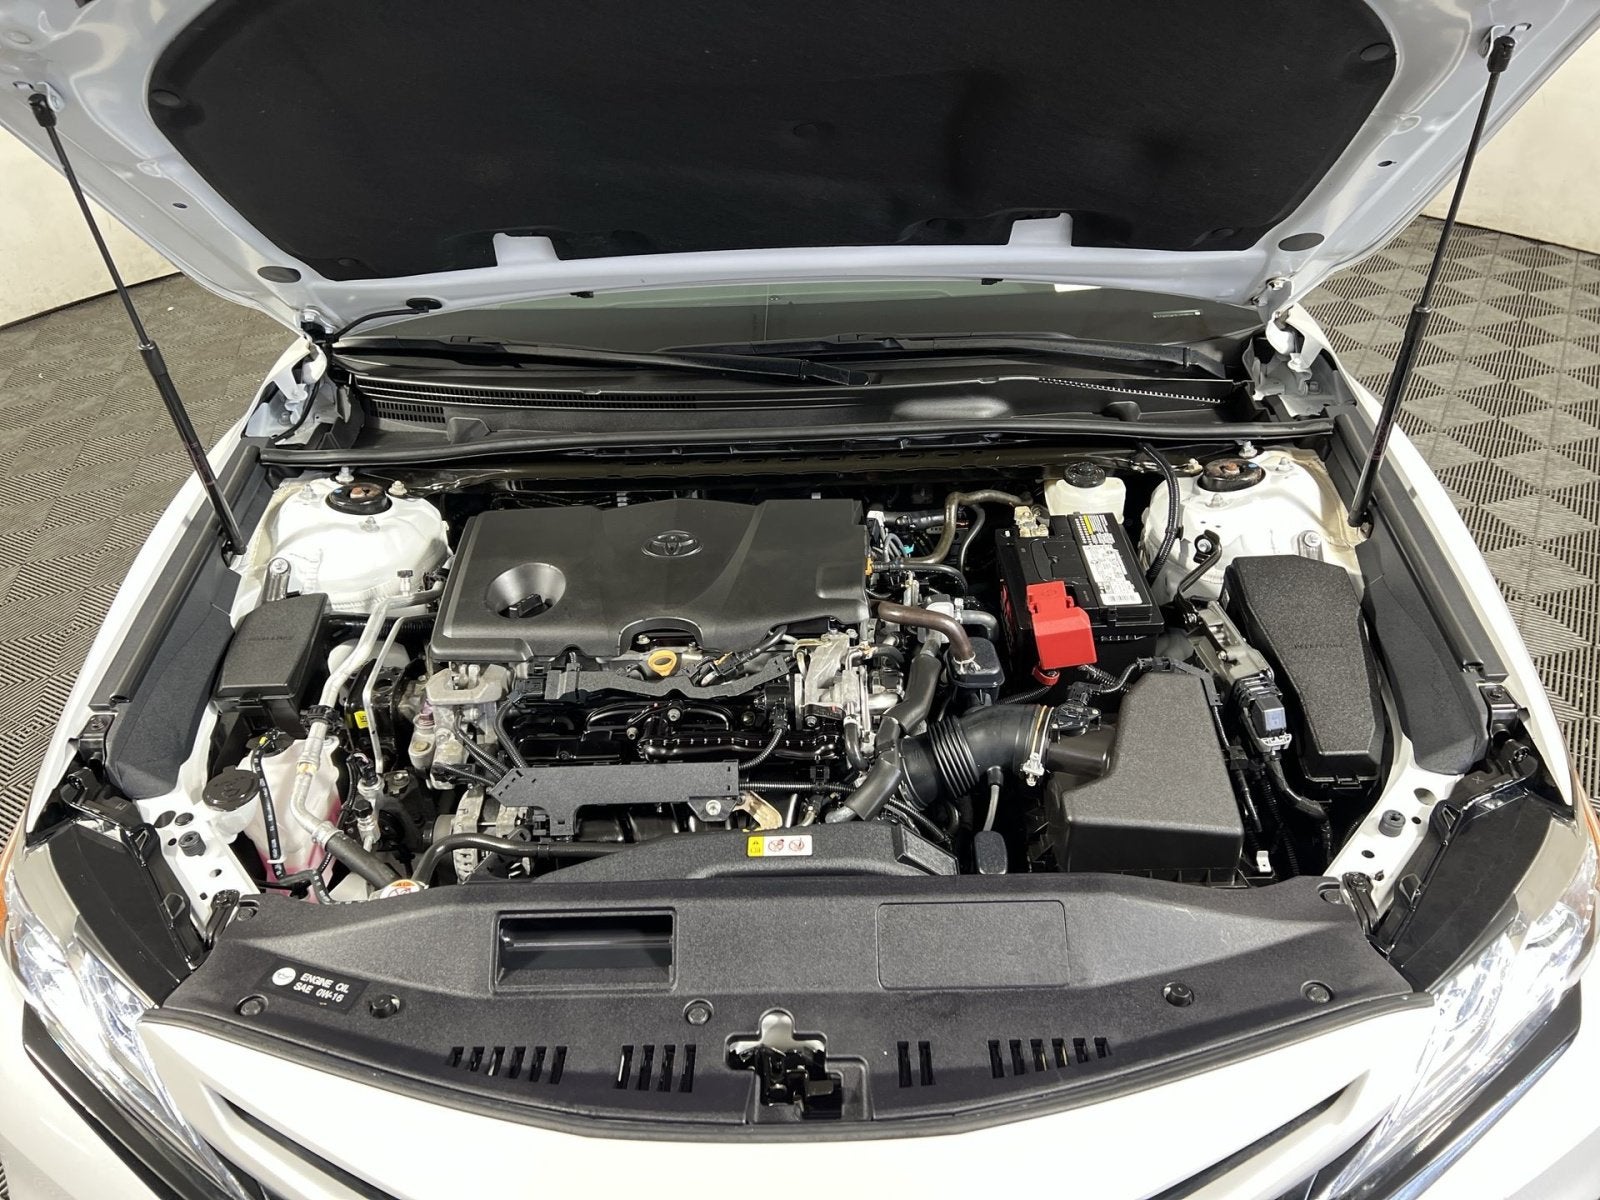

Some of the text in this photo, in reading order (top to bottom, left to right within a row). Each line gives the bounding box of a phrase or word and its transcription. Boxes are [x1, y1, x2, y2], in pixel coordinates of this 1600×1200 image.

[293, 982, 344, 1003] SAE 0W-16
[300, 972, 350, 994] ENGINE OIL
